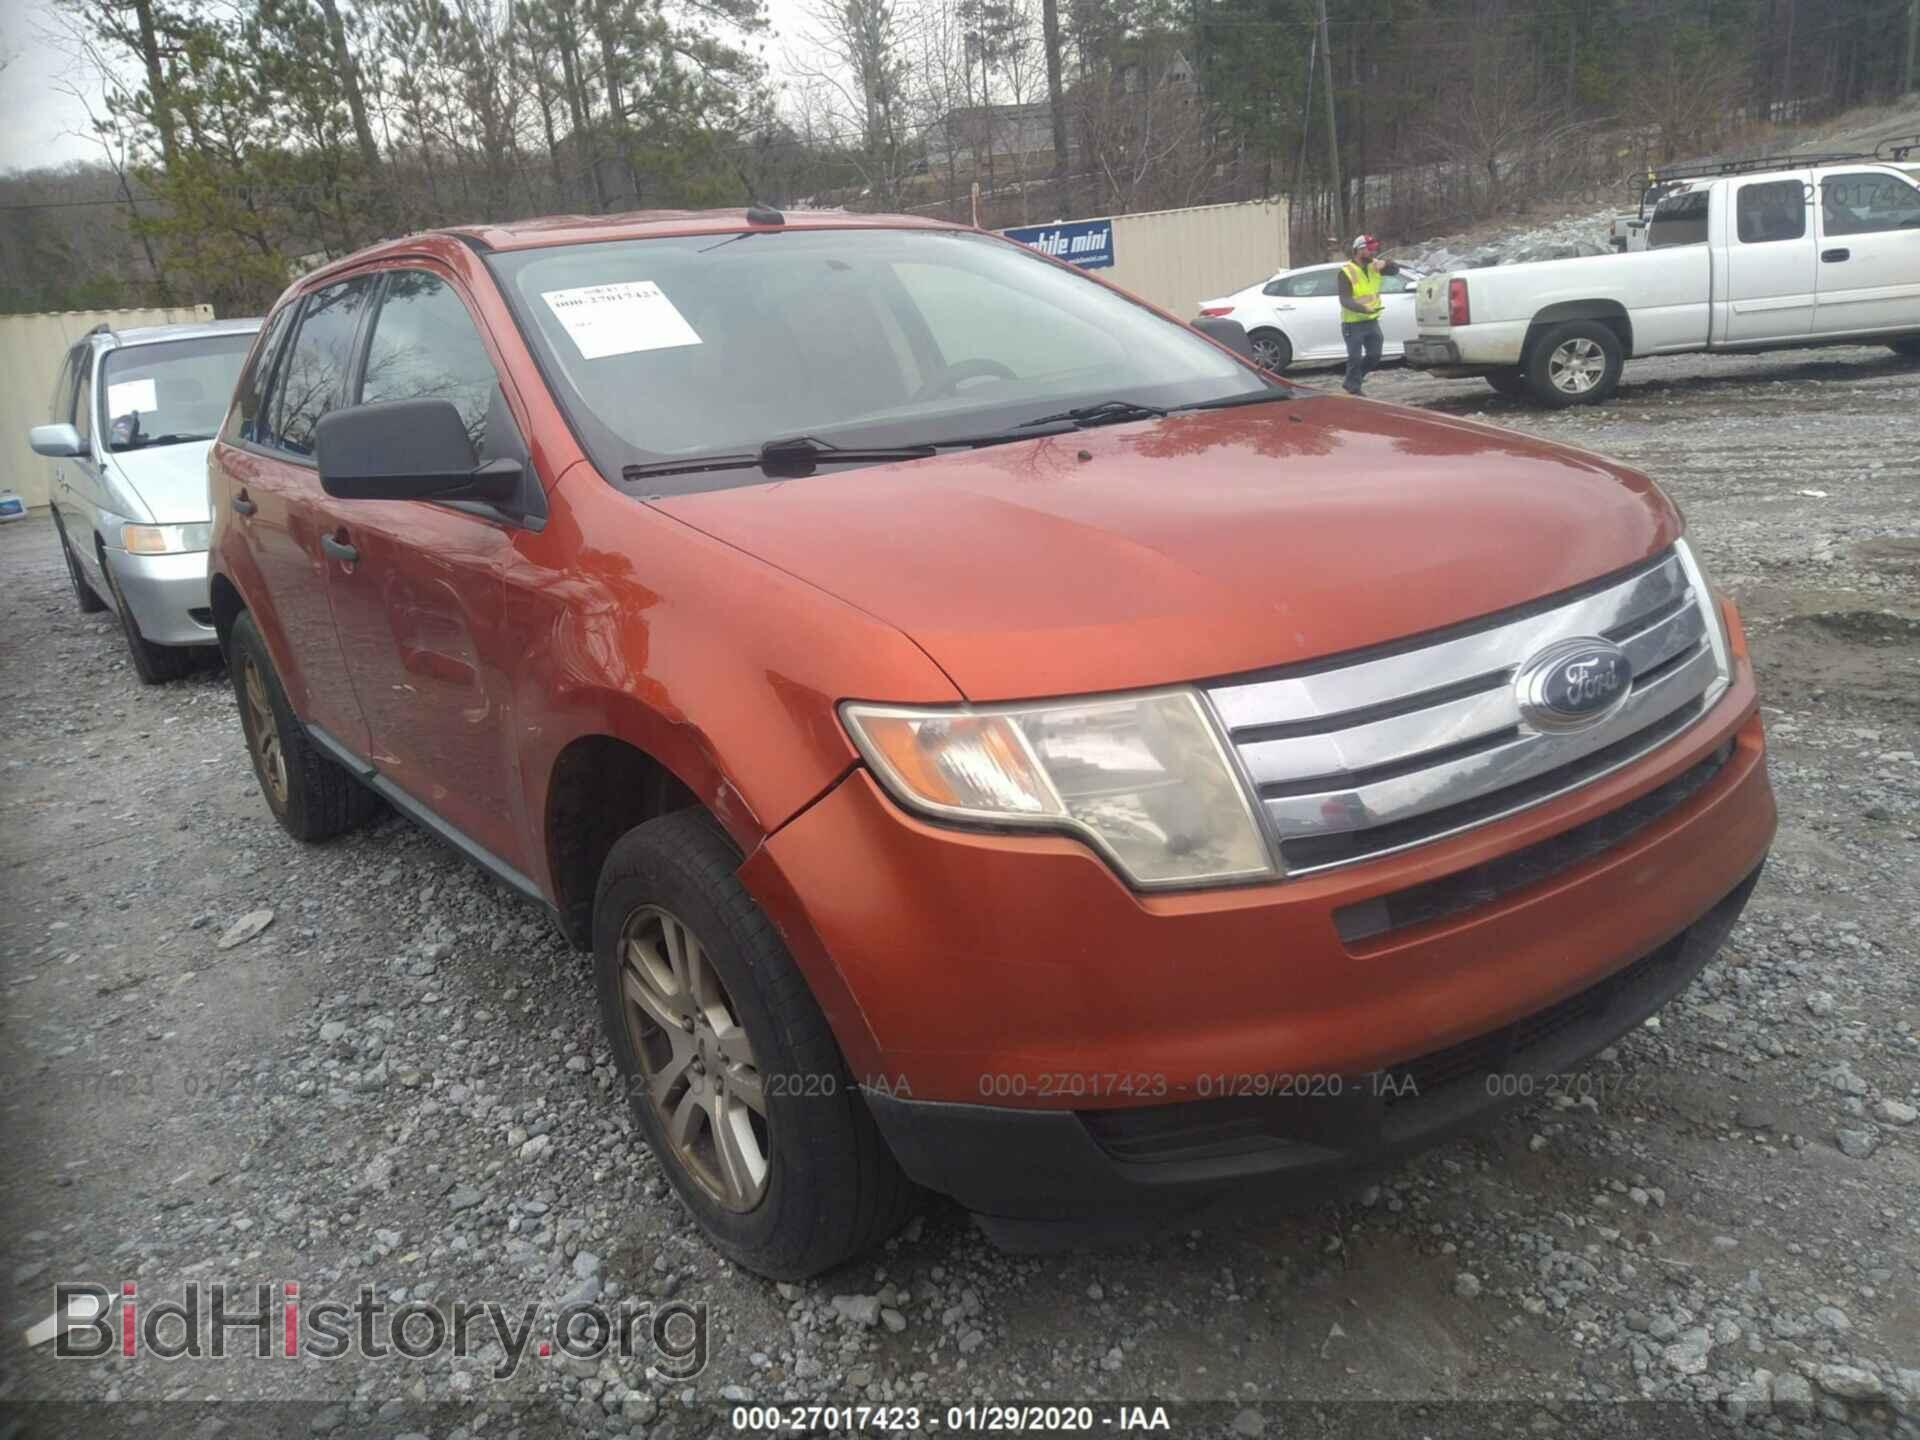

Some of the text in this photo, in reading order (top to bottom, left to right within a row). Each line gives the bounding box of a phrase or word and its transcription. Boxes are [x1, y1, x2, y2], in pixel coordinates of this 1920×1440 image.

[1025, 228, 1109, 255] bile mini
[1565, 657, 1617, 705] Ford
